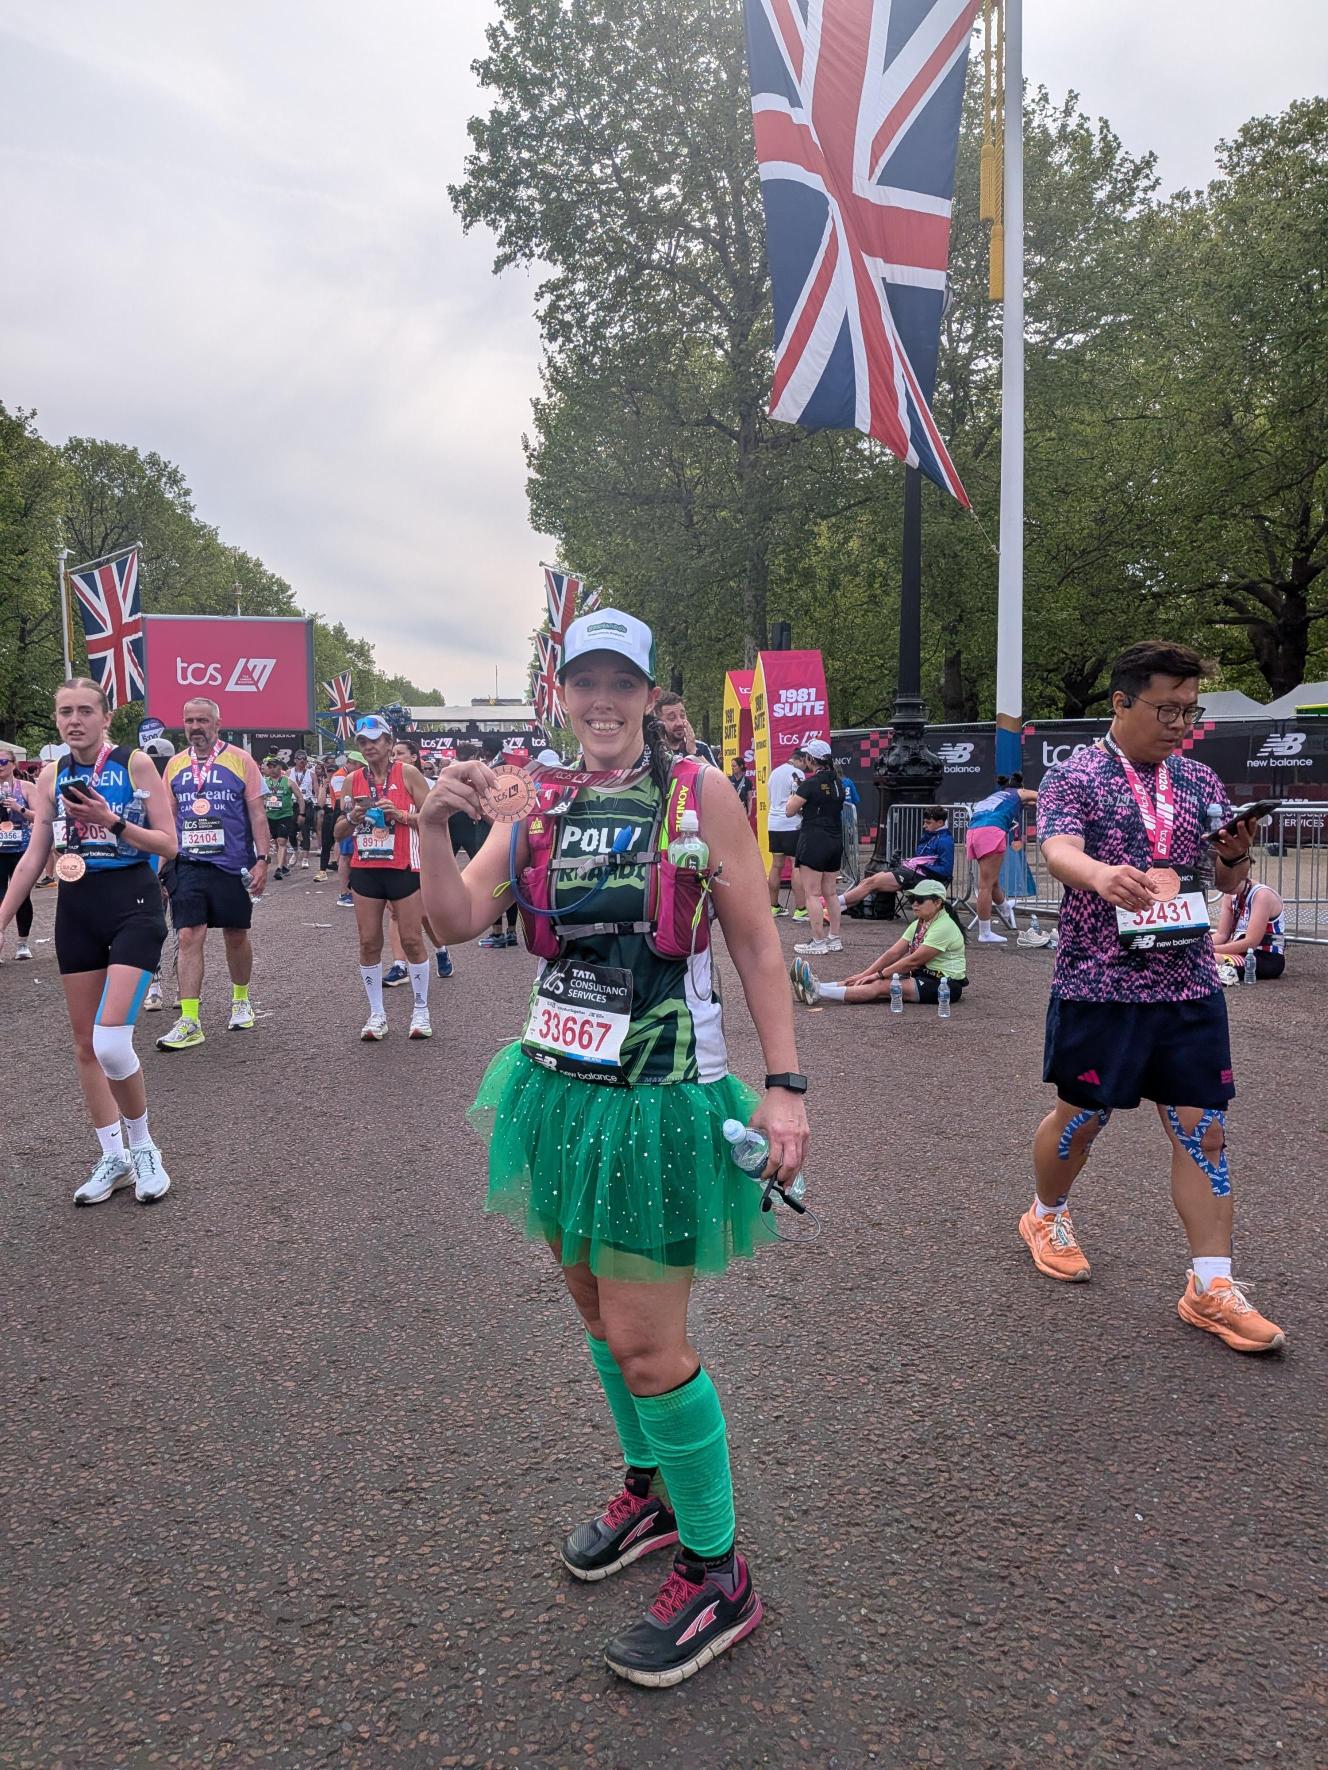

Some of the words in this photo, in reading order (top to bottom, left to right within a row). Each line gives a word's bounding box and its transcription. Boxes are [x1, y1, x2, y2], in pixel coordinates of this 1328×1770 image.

[176, 657, 222, 685] tcs
[739, 686, 752, 694] tc
[779, 688, 817, 703] 1981
[773, 701, 825, 717] SUITE
[778, 732, 799, 745] tcs
[1246, 759, 1268, 767] new
[1269, 757, 1313, 767] balance
[943, 765, 981, 773] balance
[1158, 767, 1169, 790] 2026
[176, 789, 237, 803] anceatic
[1282, 818, 1325, 827] ERVICES
[61, 823, 106, 841] 2205
[188, 832, 217, 844] 32104
[1133, 901, 1191, 926] 32431
[1156, 940, 1172, 948] new
[572, 969, 596, 981] TATA
[567, 988, 607, 1004] SERVICES
[539, 1008, 612, 1052] 33667
[577, 1071, 618, 1083] balance
